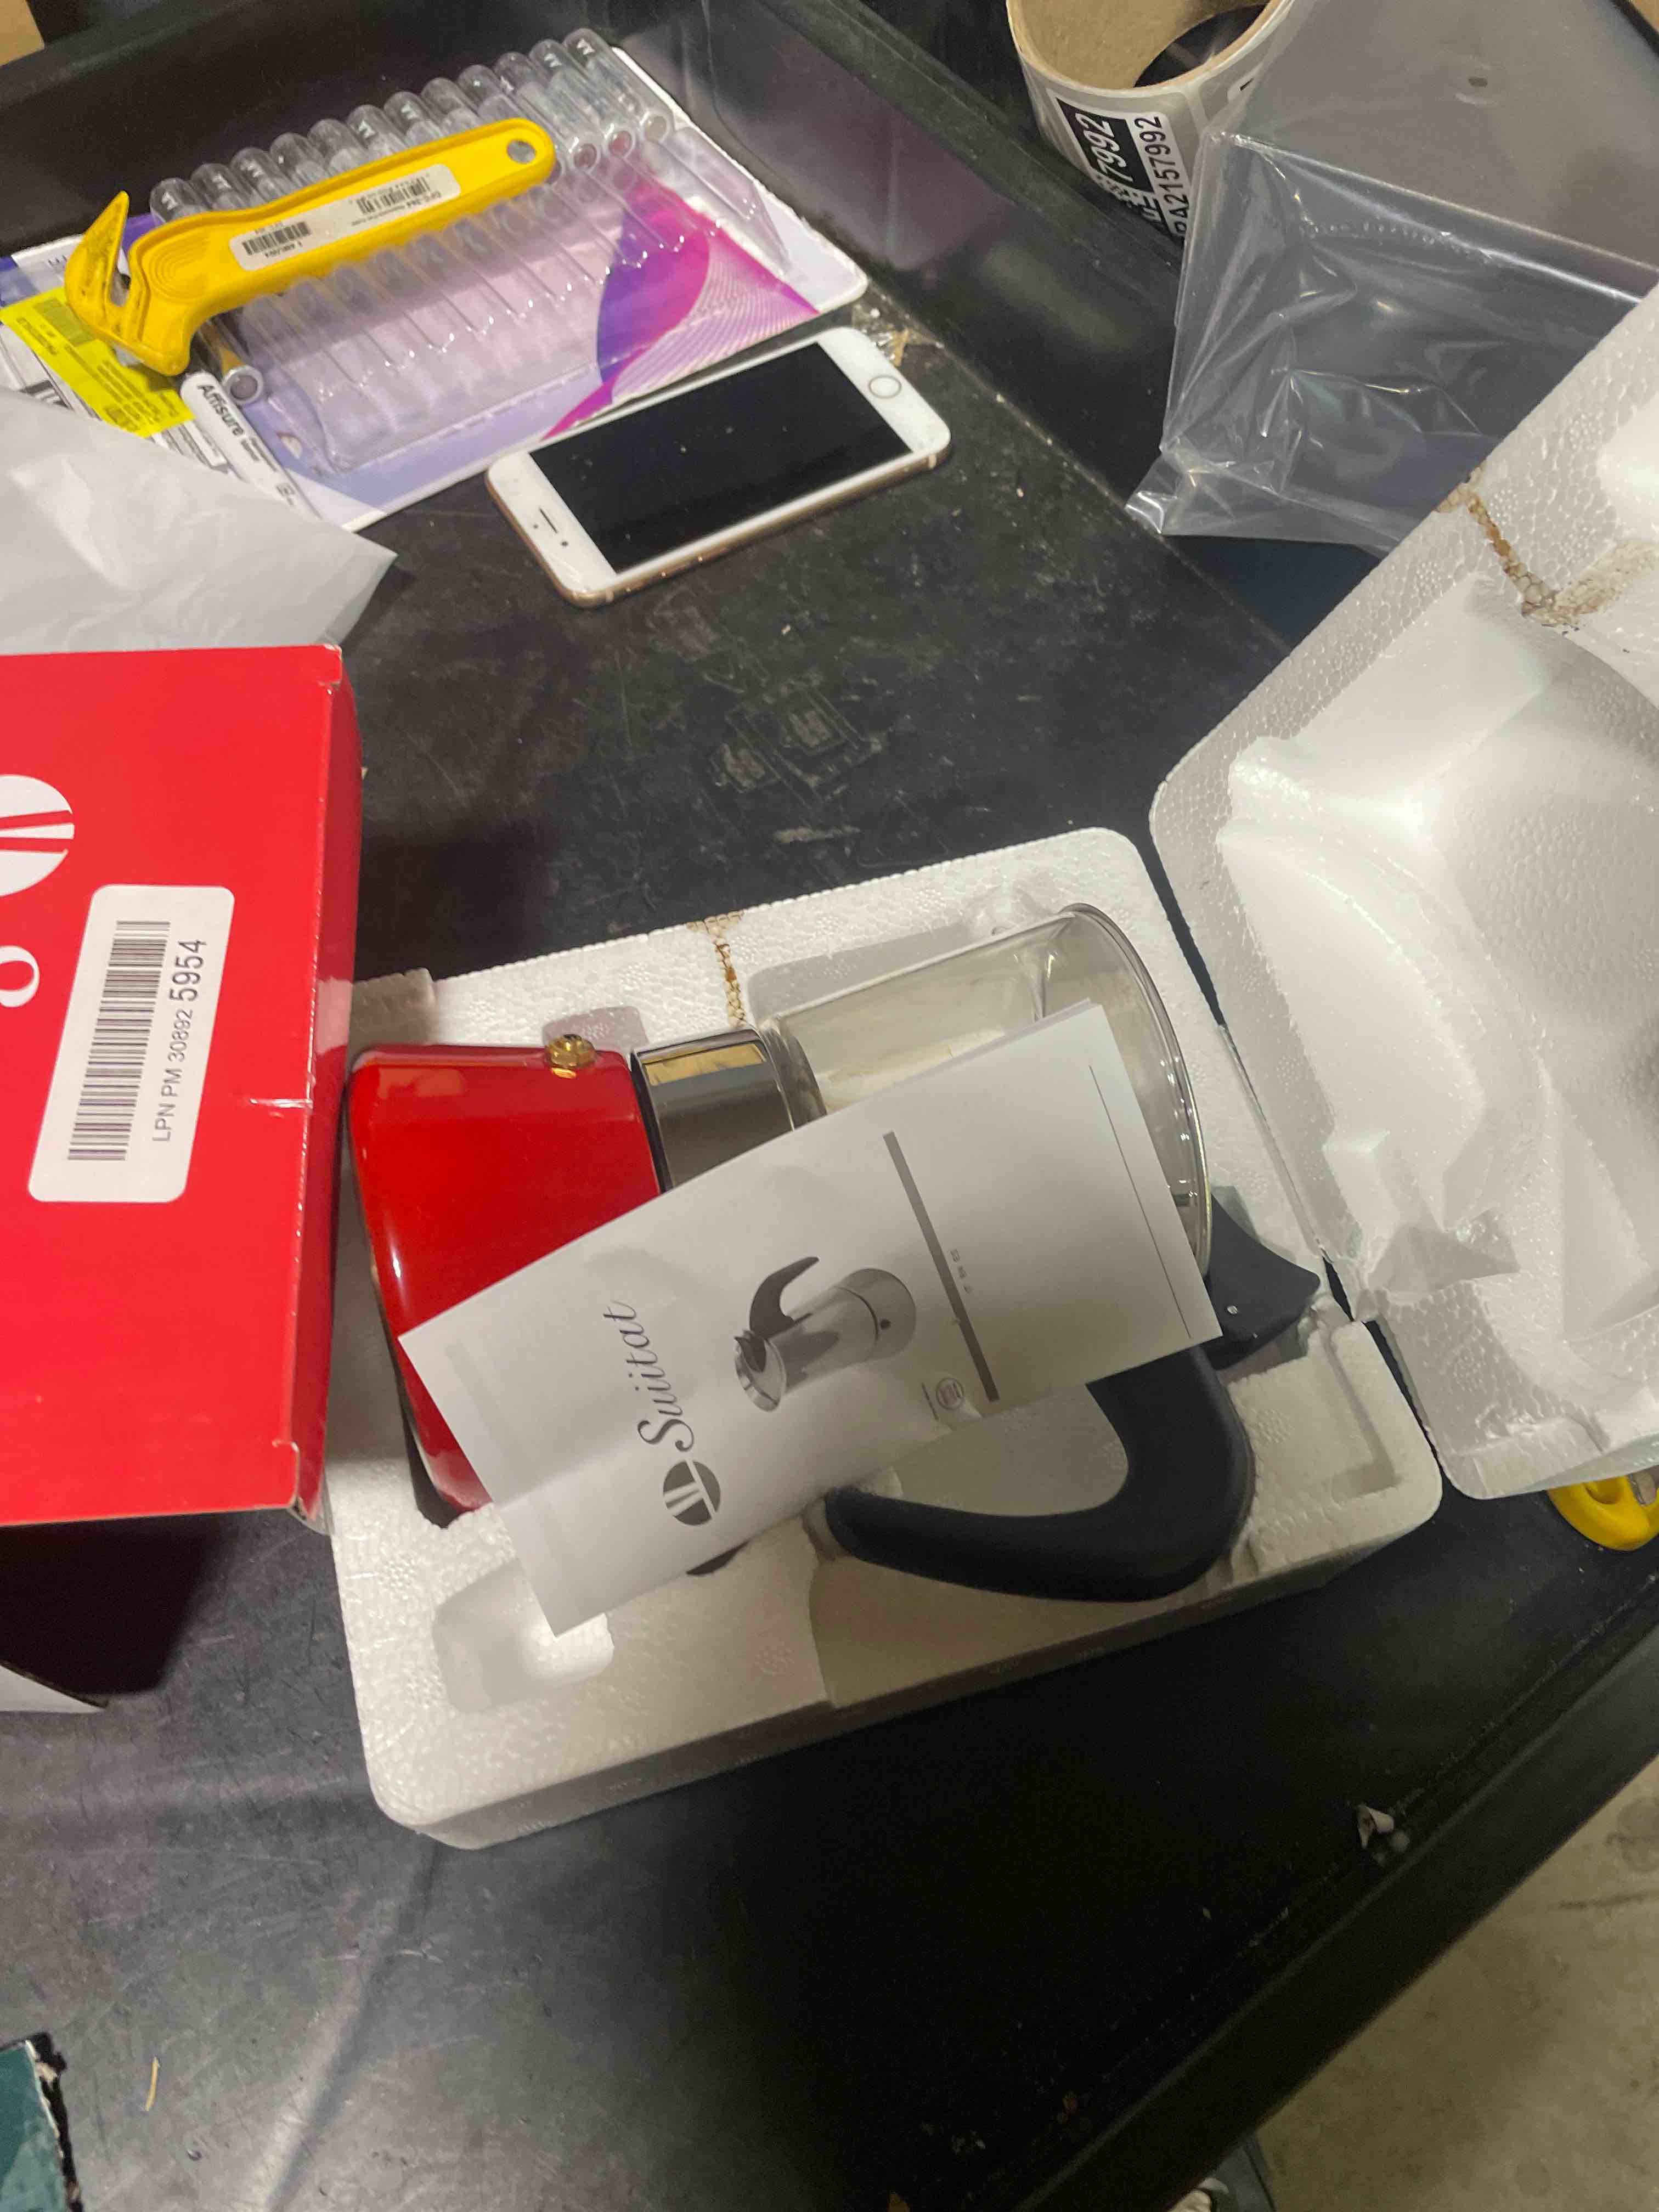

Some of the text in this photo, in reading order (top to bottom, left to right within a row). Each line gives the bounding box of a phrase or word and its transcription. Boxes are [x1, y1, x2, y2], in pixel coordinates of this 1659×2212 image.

[1075, 112, 1133, 183] 7992
[153, 940, 207, 1142] LPN PM 30892 5954
